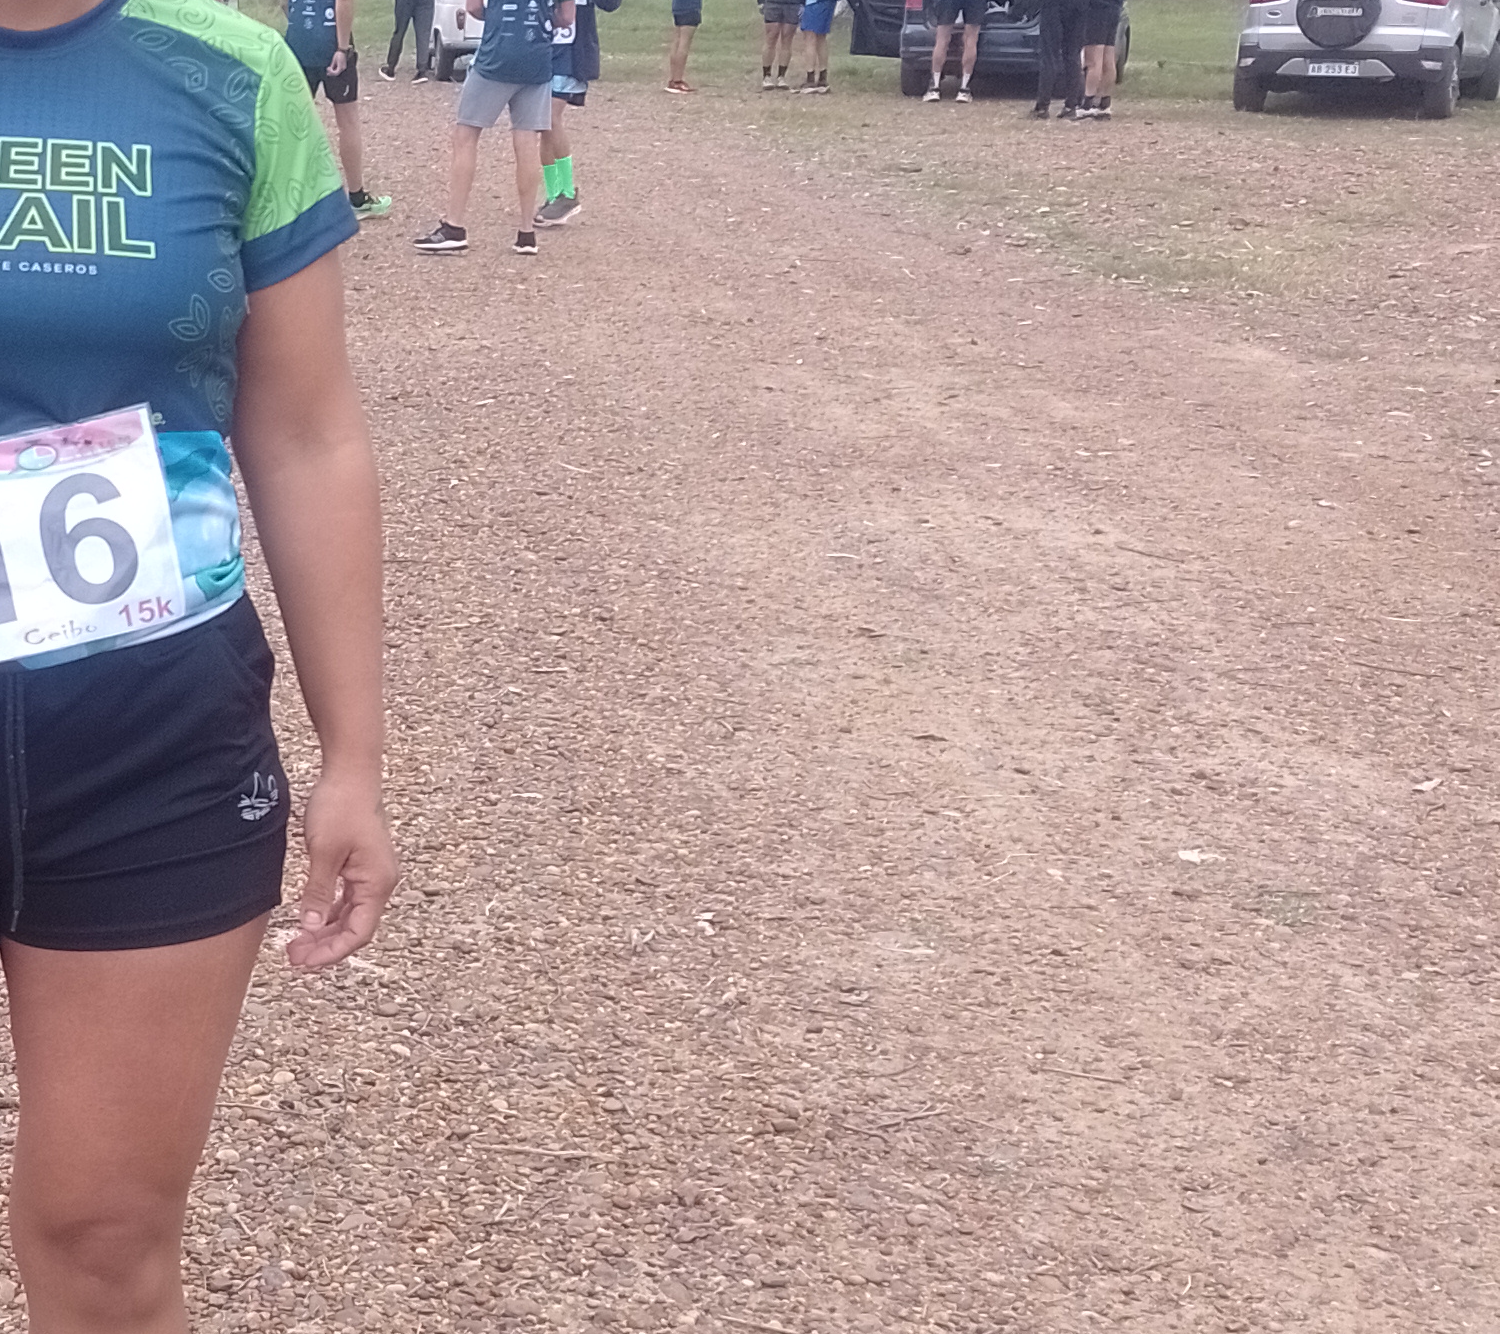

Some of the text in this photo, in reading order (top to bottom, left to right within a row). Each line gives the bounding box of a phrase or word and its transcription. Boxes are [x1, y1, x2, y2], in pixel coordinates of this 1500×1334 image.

[18, 261, 98, 276] CASEROS
[118, 596, 175, 627] 15k
[24, 620, 98, 645] Ceibo
